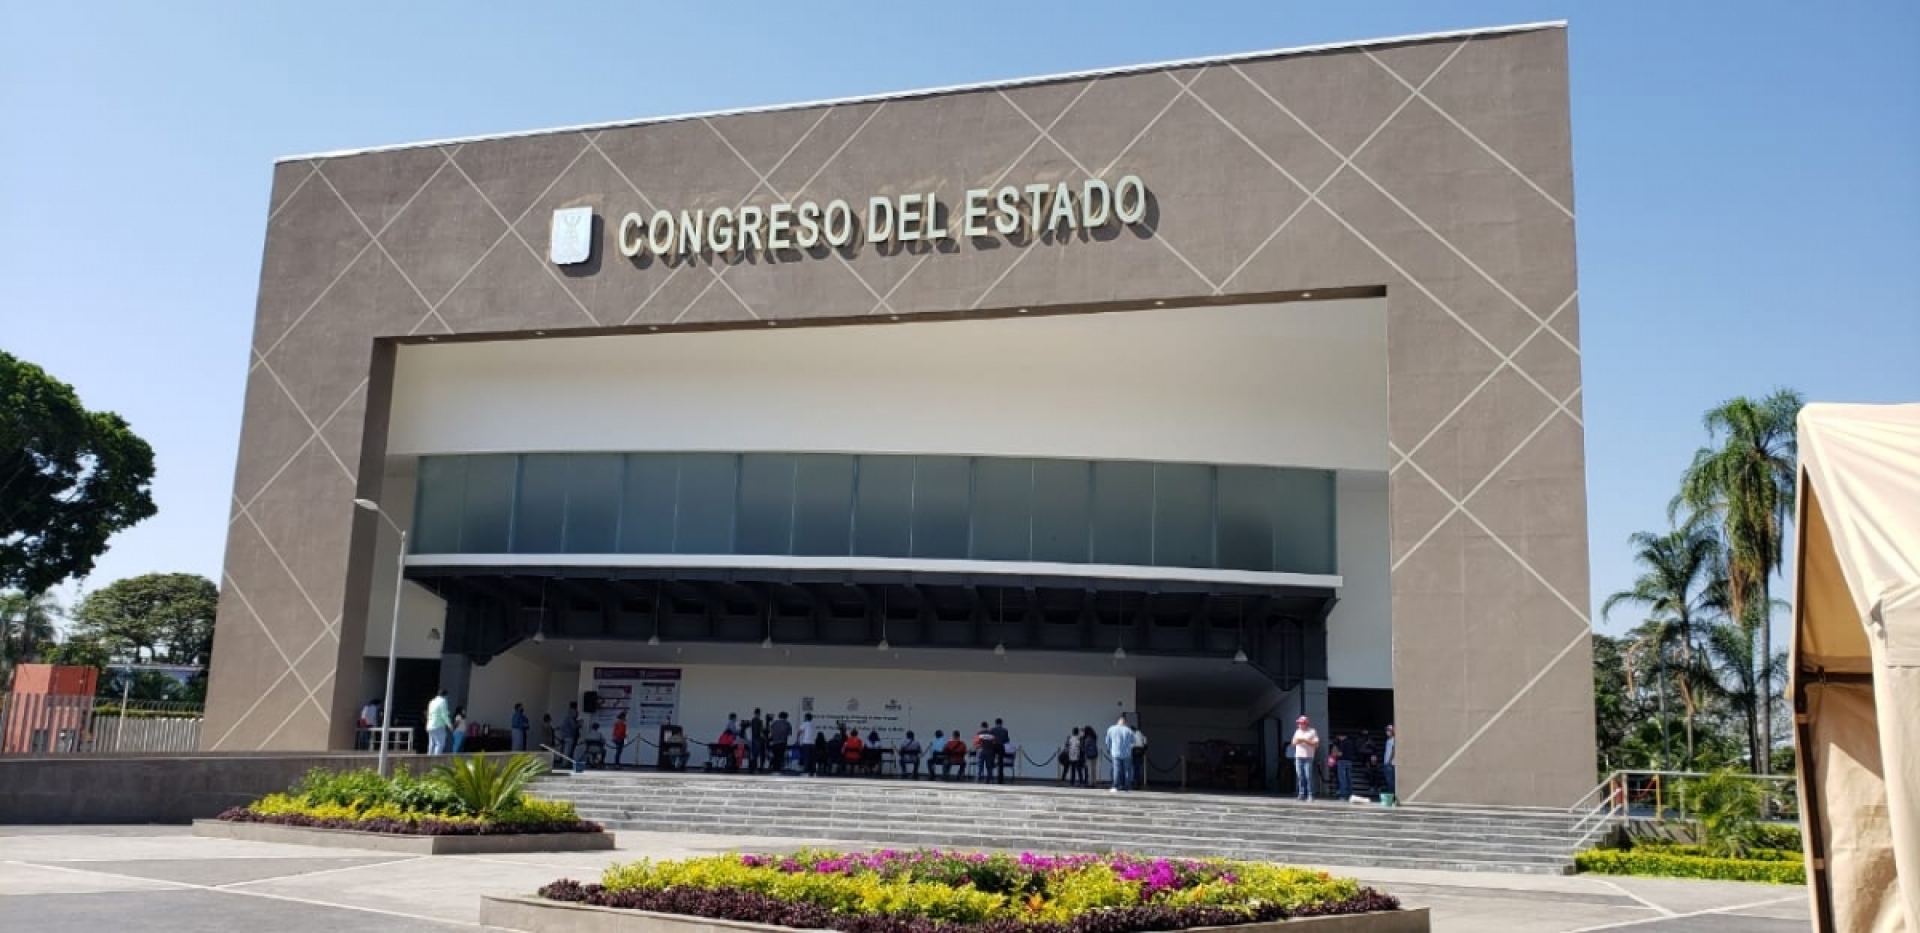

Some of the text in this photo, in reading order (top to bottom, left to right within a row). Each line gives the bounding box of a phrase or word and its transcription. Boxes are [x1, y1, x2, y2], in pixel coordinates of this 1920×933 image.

[619, 174, 1146, 257] CONGRESO DEL ESTADO
